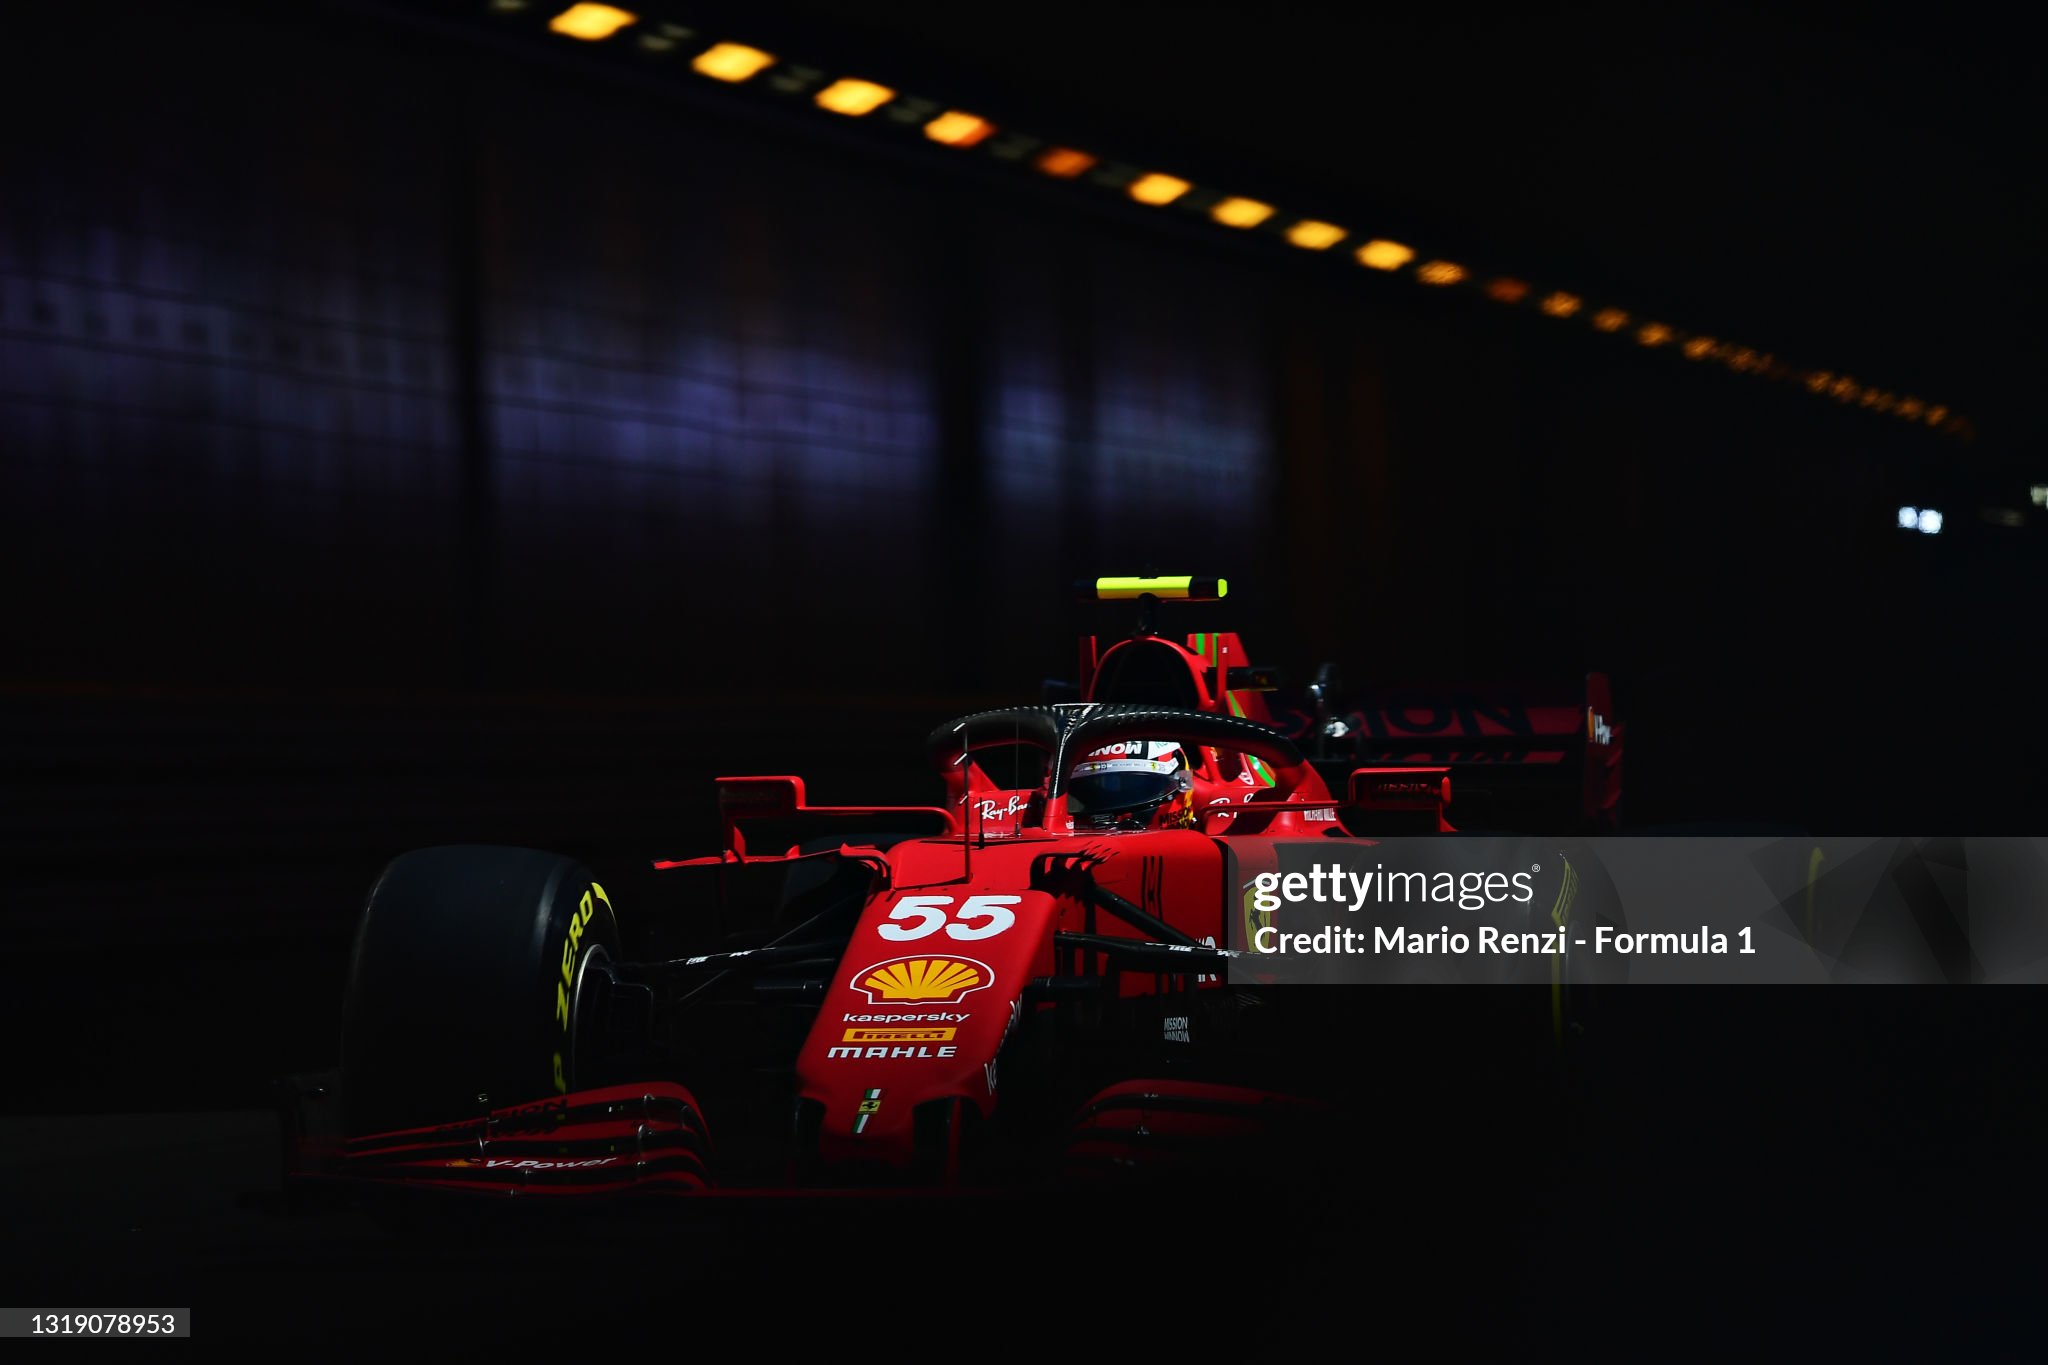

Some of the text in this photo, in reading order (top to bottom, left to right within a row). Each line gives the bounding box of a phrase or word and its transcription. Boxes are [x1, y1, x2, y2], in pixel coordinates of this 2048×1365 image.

[877, 895, 1022, 941] 55
[555, 889, 594, 1034] ZERO
[843, 1012, 971, 1024] kaspersky
[827, 1046, 958, 1059] MAHLE
[486, 1157, 618, 1169] V-Power
